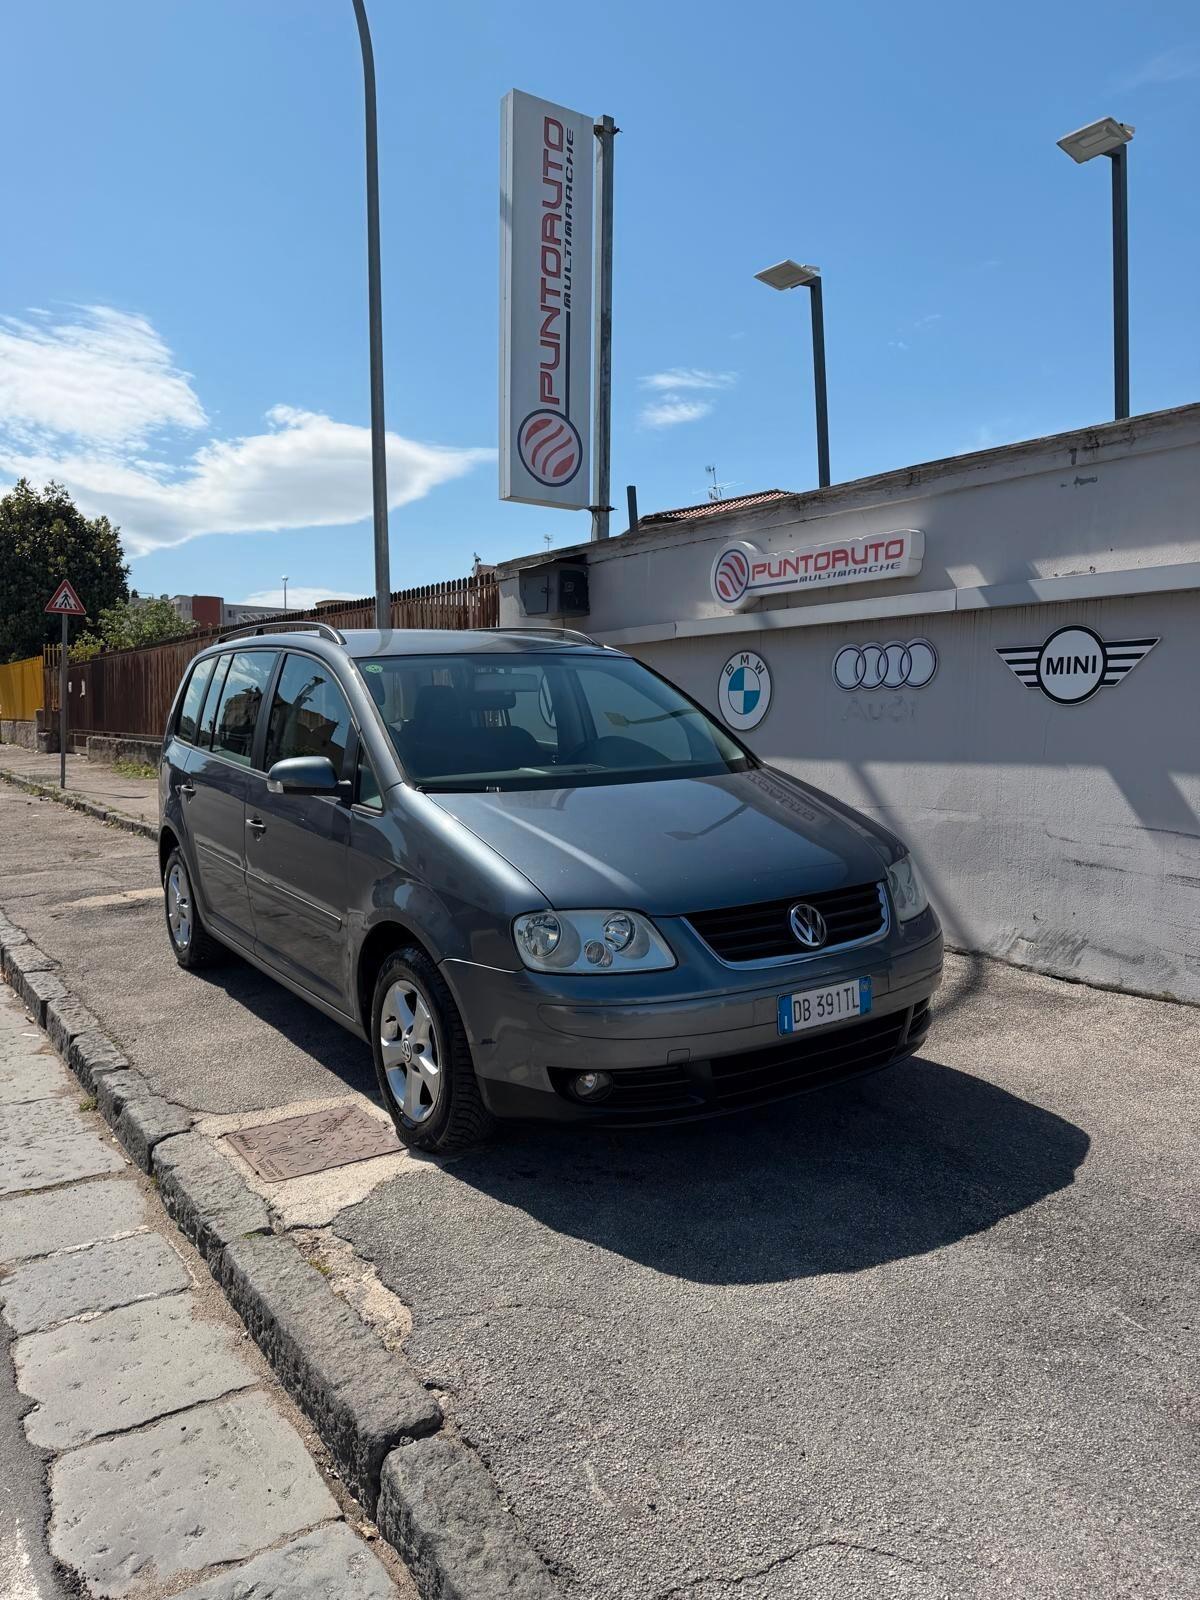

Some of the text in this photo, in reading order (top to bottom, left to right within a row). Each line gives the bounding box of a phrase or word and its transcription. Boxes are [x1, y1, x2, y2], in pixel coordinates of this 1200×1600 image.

[563, 127, 574, 309] MULTIMARCHE
[540, 116, 564, 405] PUNTOAUTO
[752, 538, 904, 581] PUNTOAUTO
[798, 562, 902, 583] MULTIMARCHE
[725, 654, 765, 677] BMW
[1046, 655, 1097, 675] MINI
[793, 999, 811, 1024] DB
